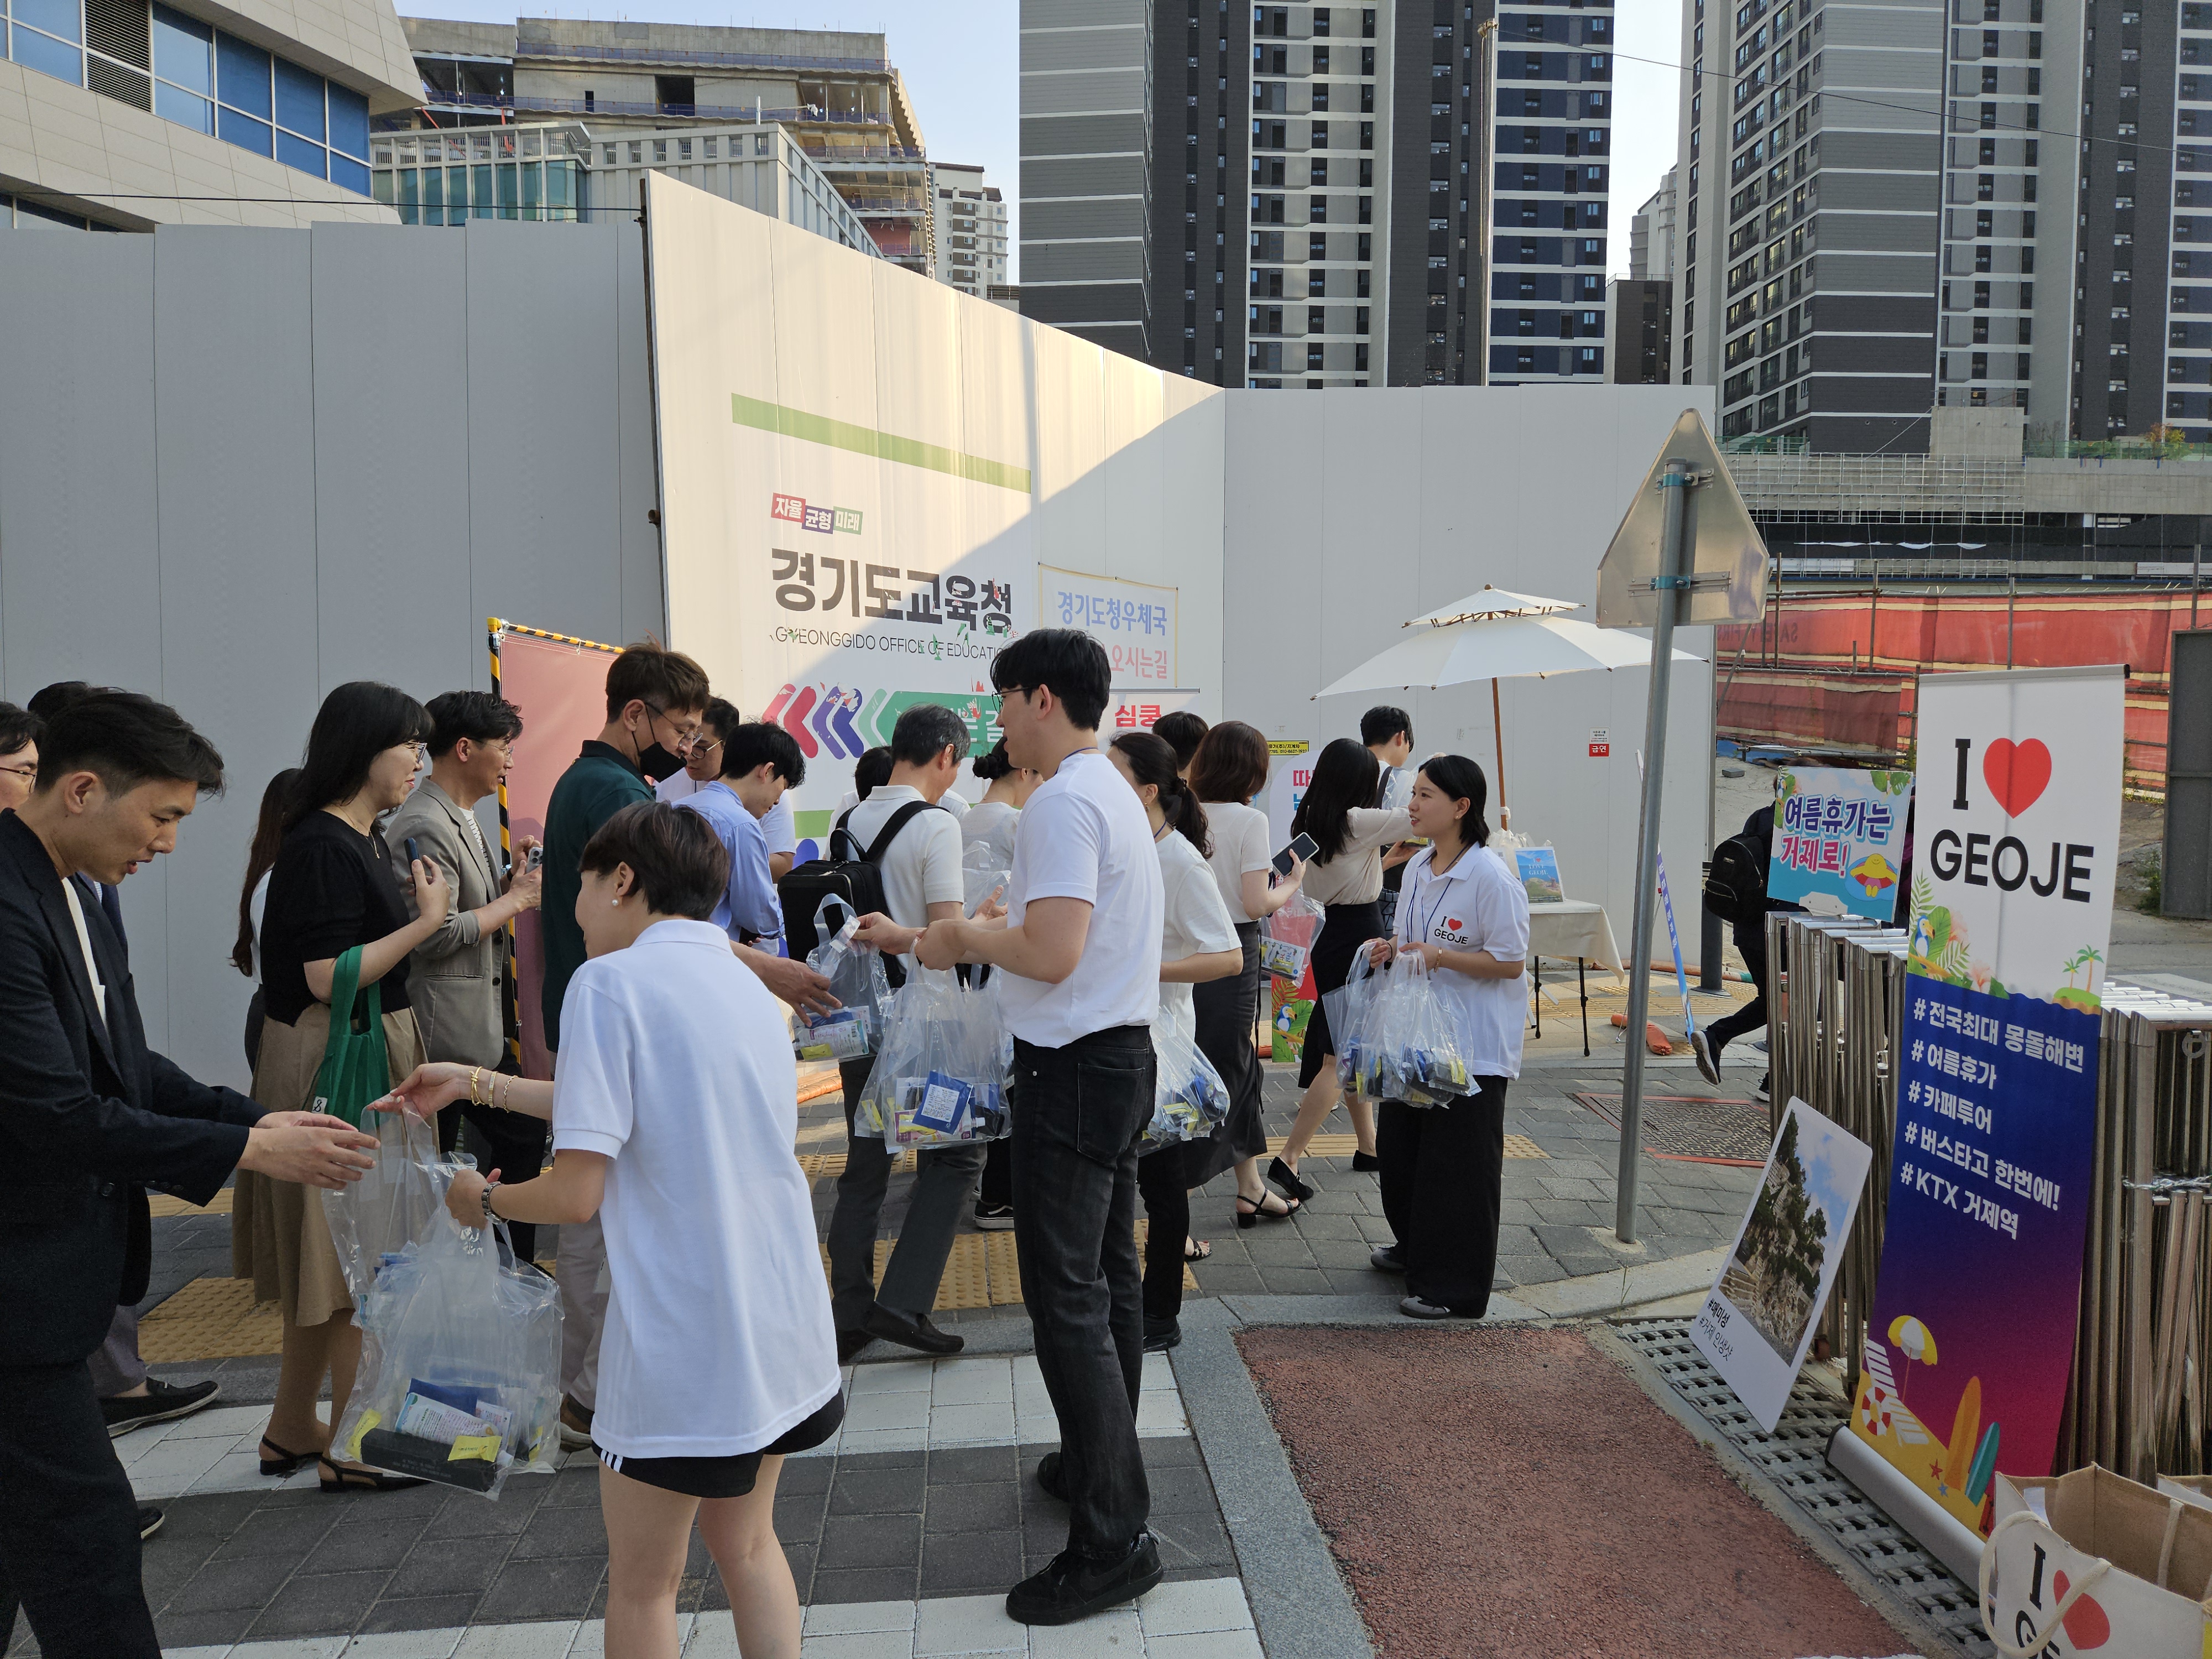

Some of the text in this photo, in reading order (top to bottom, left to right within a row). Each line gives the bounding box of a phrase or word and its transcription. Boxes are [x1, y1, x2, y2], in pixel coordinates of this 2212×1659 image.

[774, 497, 860, 531] 자율 균형 미래
[771, 548, 1011, 635] 경기도교육청
[1057, 591, 1167, 636] 경기도청우체국
[775, 626, 875, 650] GYEONGGIDO
[879, 636, 925, 654] OFFICE
[928, 641, 944, 656] OF
[1110, 644, 1167, 679] 오시는길
[1115, 705, 1162, 727] 심쿵
[1953, 738, 1971, 810] I
[1784, 795, 1892, 839] 여름휴가는
[1781, 836, 1850, 878] 거제로!
[1931, 829, 2094, 903] GEOJE
[1434, 928, 1468, 945] GEOJE
[1440, 916, 1447, 927] I
[2005, 1024, 2084, 1073] 몽돌해변
[1995, 1159, 2060, 1212] 한번에!
[1963, 1190, 2018, 1240] 거제역
[1707, 1298, 1730, 1328] #매미성
[1713, 1332, 1734, 1361] 인생샷
